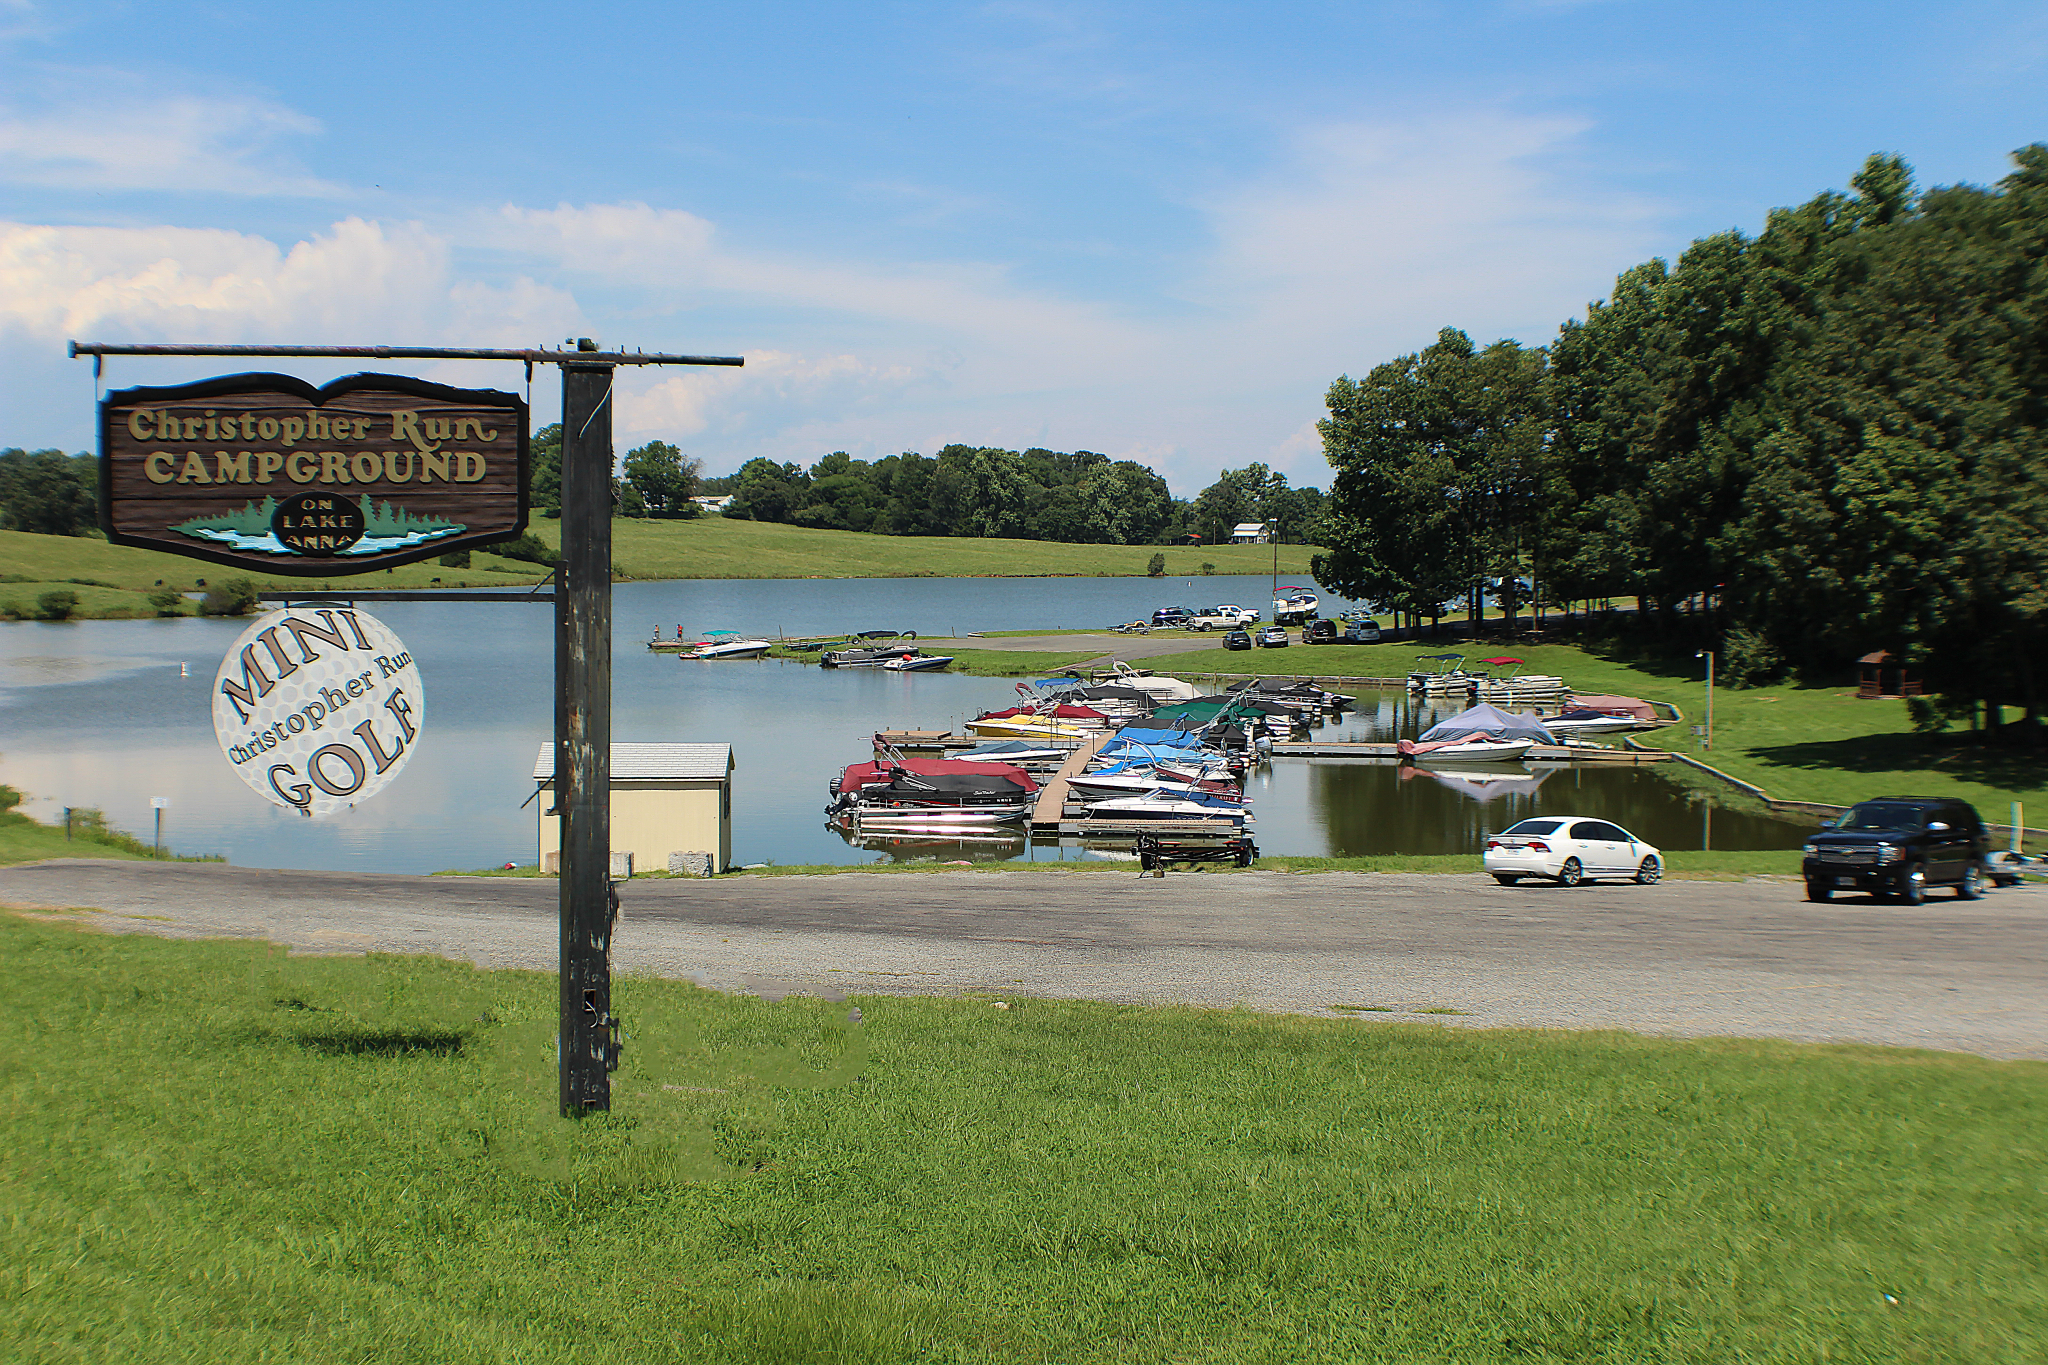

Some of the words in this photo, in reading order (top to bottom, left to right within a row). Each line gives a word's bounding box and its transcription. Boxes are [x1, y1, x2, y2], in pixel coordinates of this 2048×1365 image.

[127, 409, 371, 447] Christopher
[391, 409, 498, 452] Run
[143, 450, 488, 485] CAMPGROUND
[282, 515, 353, 529] LAKE
[300, 498, 333, 511] ON
[285, 534, 354, 549] ANNA
[221, 609, 373, 726] MINI
[228, 670, 375, 766] Christopher
[373, 650, 412, 680] Run
[267, 687, 416, 806] GOLF
